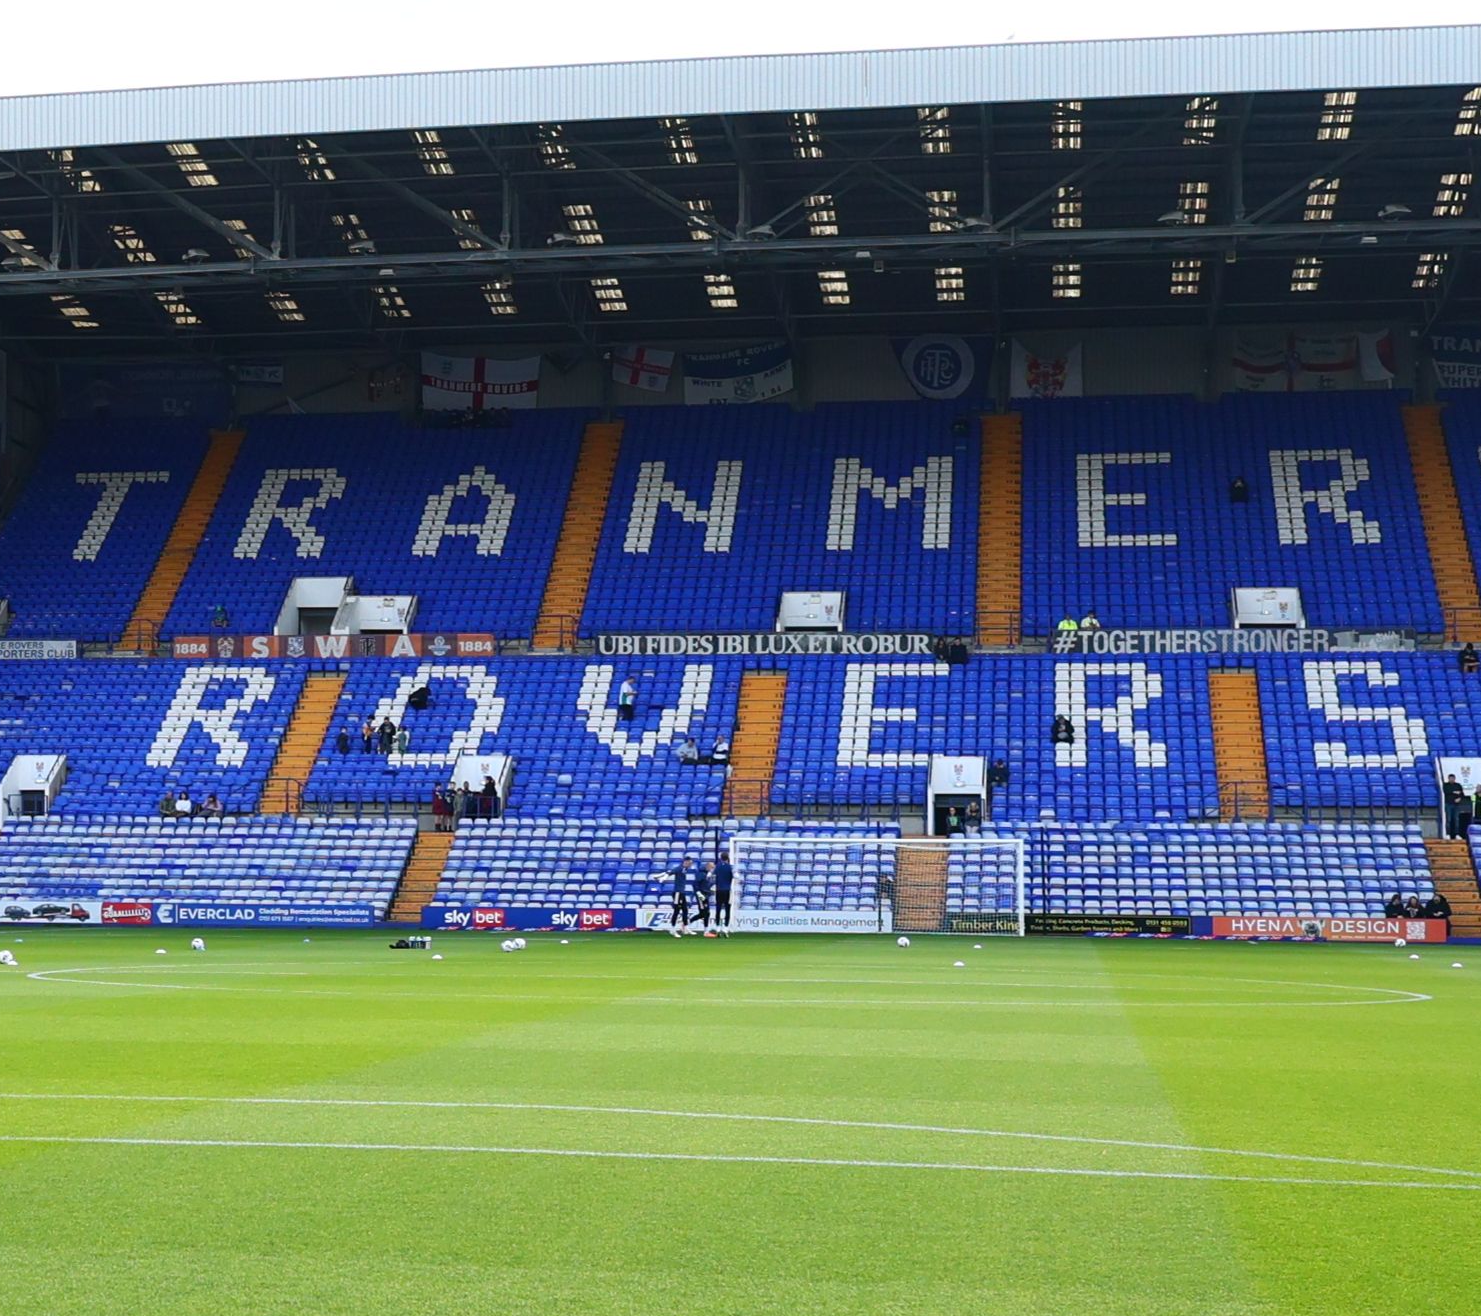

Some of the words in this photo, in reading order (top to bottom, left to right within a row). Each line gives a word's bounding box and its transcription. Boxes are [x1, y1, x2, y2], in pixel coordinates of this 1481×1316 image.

[430, 376, 483, 393] TRANMERE
[487, 382, 528, 394] ROVERS
[7, 641, 44, 650] ROVERS
[175, 642, 208, 654] 1884
[251, 636, 269, 659] S
[314, 636, 349, 658] W
[391, 635, 417, 657] A
[458, 641, 492, 653] 1884
[598, 636, 642, 655] UBI
[644, 635, 713, 655] FIDES
[716, 635, 752, 655] IBI
[753, 635, 806, 654] LUX
[807, 635, 838, 654] ET
[840, 634, 933, 654] ROBUR
[46, 648, 74, 658] CLUB
[146, 660, 1429, 770] ROVERS
[179, 908, 255, 921] EVERCLAD
[258, 907, 289, 916] Cladding
[444, 909, 471, 926] sky
[475, 910, 502, 924] bet
[551, 910, 578, 927] sky
[583, 911, 610, 925] bet
[762, 915, 809, 927] Facilities
[951, 919, 992, 931] Timber
[1231, 919, 1295, 932] HYENA
[1330, 920, 1400, 934] DESIGN
